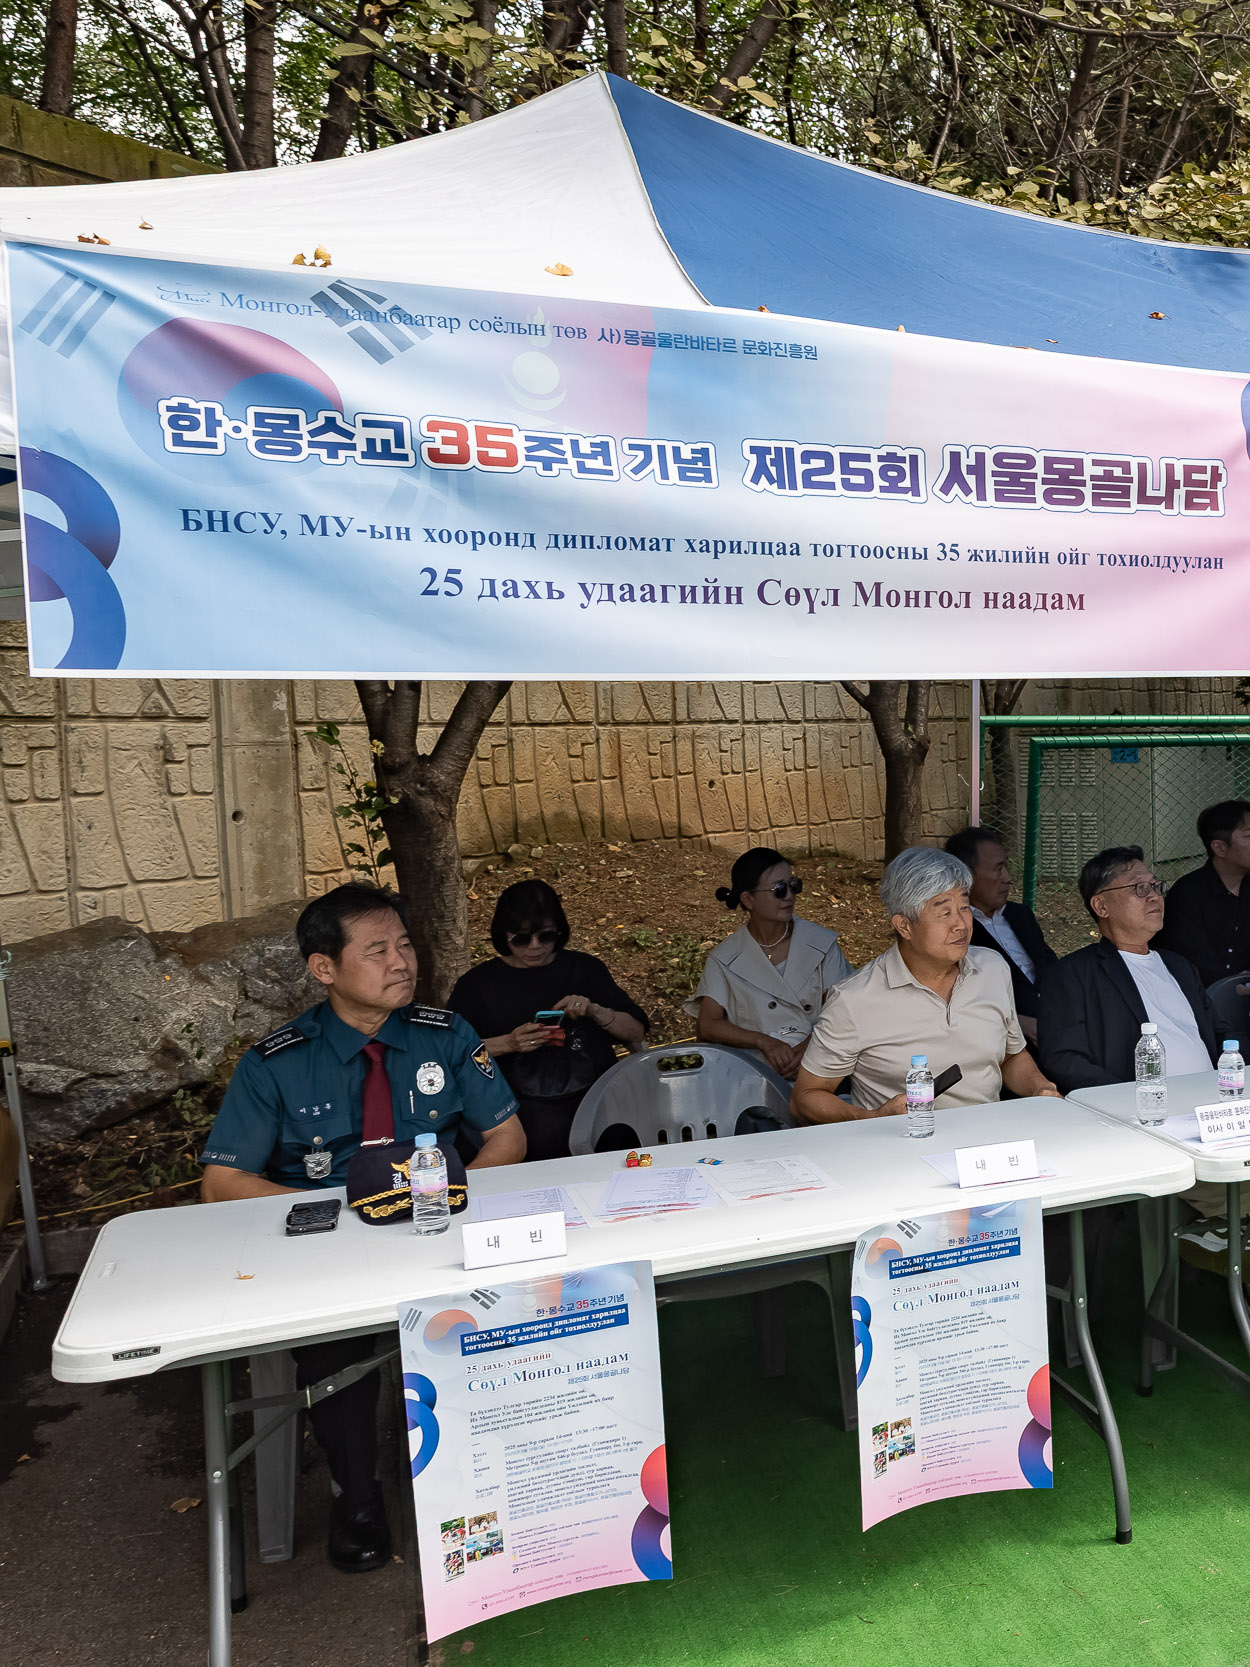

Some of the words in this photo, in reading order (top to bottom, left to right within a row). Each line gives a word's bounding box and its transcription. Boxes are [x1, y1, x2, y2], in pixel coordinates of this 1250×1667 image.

[219, 291, 461, 333] Монгол-Улаанбаатар
[469, 316, 545, 336] соёлын
[552, 324, 587, 339] төв
[742, 339, 818, 360] 문화진흥원
[624, 438, 718, 489] 기념
[743, 437, 926, 503] 제25회
[933, 444, 1225, 517] 서울몽골나담
[180, 508, 288, 540] БНСУ,
[299, 513, 412, 543] МУ-ын
[423, 525, 536, 551] хооронд
[546, 531, 675, 555] дипломат
[684, 535, 801, 560] харилцаа
[809, 540, 929, 563] тогтоосны
[936, 542, 960, 562] 35
[967, 546, 1050, 566] жилийн
[1057, 548, 1091, 568] ойг
[1097, 550, 1224, 571] тохиолдуулан
[420, 567, 464, 597] 25
[478, 574, 565, 602] дахь
[579, 578, 743, 609] удаагийн
[757, 578, 841, 614] Сөүл
[853, 580, 972, 610] Монгол
[982, 587, 1086, 612] наадам
[1208, 1124, 1223, 1133] 이사
[976, 1160, 986, 1170] 내
[1009, 1155, 1019, 1166] 빈
[487, 1235, 500, 1248] 내
[529, 1229, 542, 1243] 빈
[928, 1289, 973, 1304] Монгол
[977, 1280, 1019, 1294] наадам
[507, 1336, 517, 1344] 35
[549, 1327, 563, 1336] ойг
[466, 1365, 478, 1375] 25
[467, 1376, 507, 1392] Сөүл
[513, 1363, 571, 1385] Монгол
[576, 1352, 629, 1371] наадам
